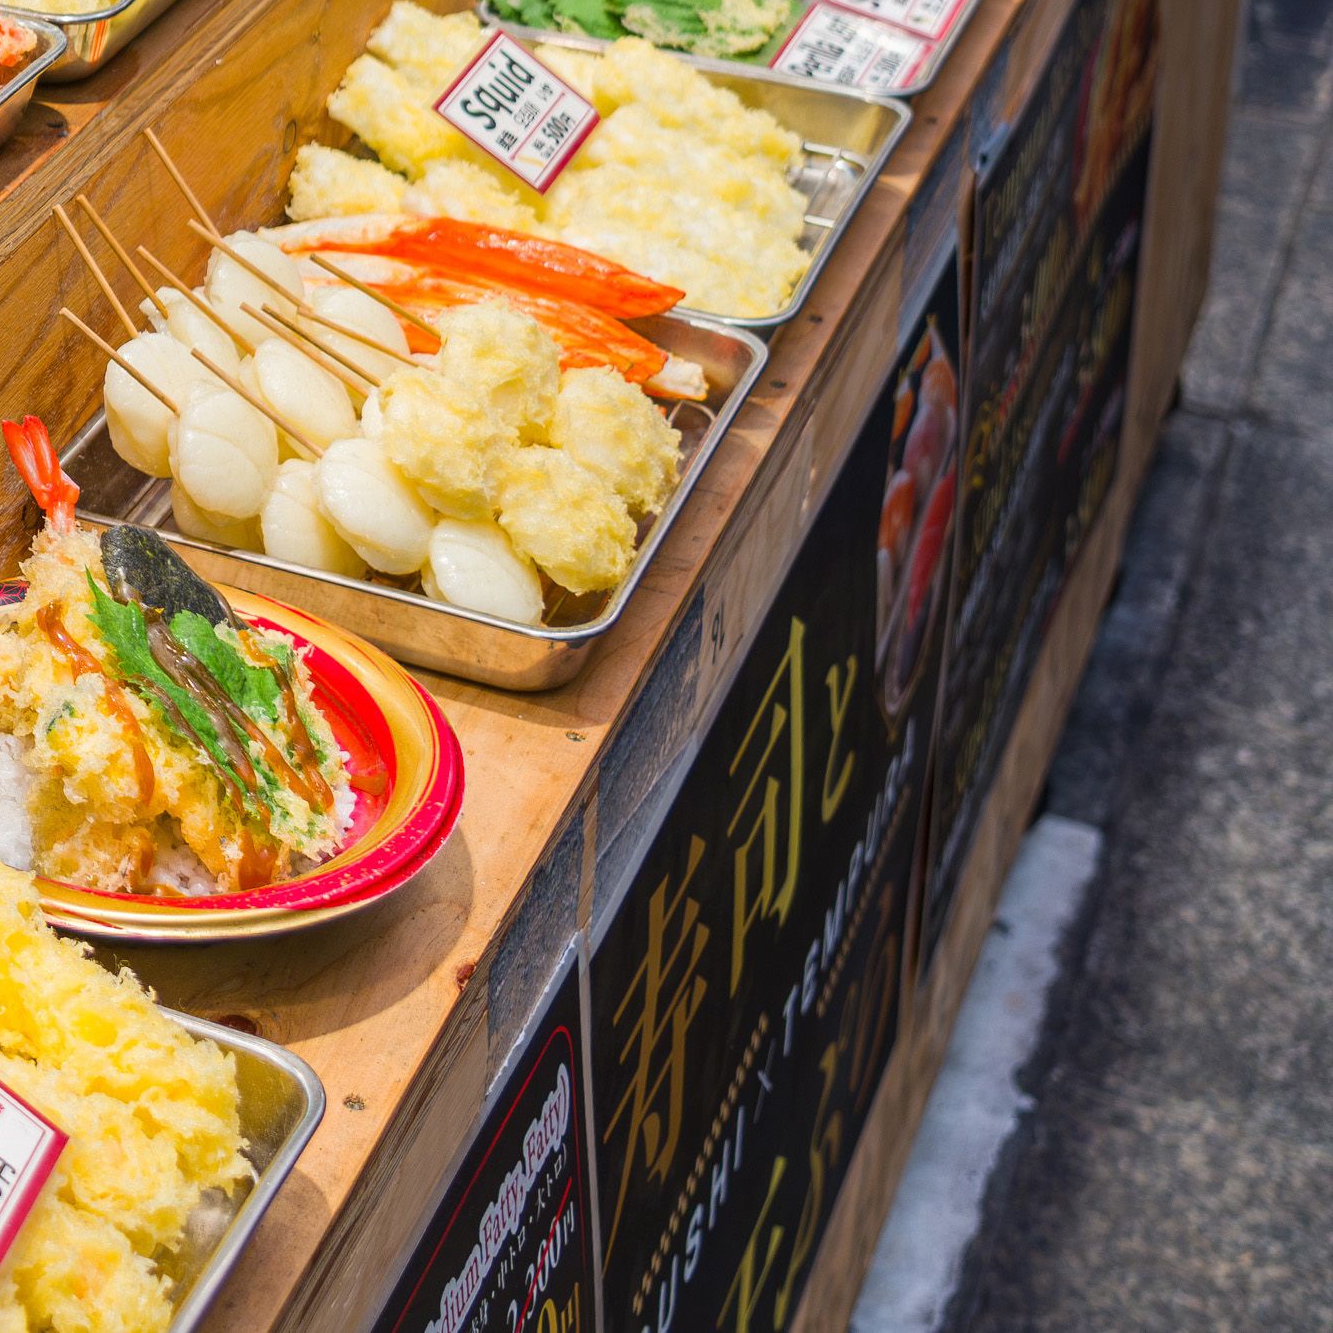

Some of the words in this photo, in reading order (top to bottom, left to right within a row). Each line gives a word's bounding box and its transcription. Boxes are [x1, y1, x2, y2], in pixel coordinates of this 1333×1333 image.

[460, 48, 535, 130] Squid
[482, 1175, 525, 1262] Fatty,
[526, 1073, 567, 1179] Fatty)
[641, 1103, 746, 1333] USHI
